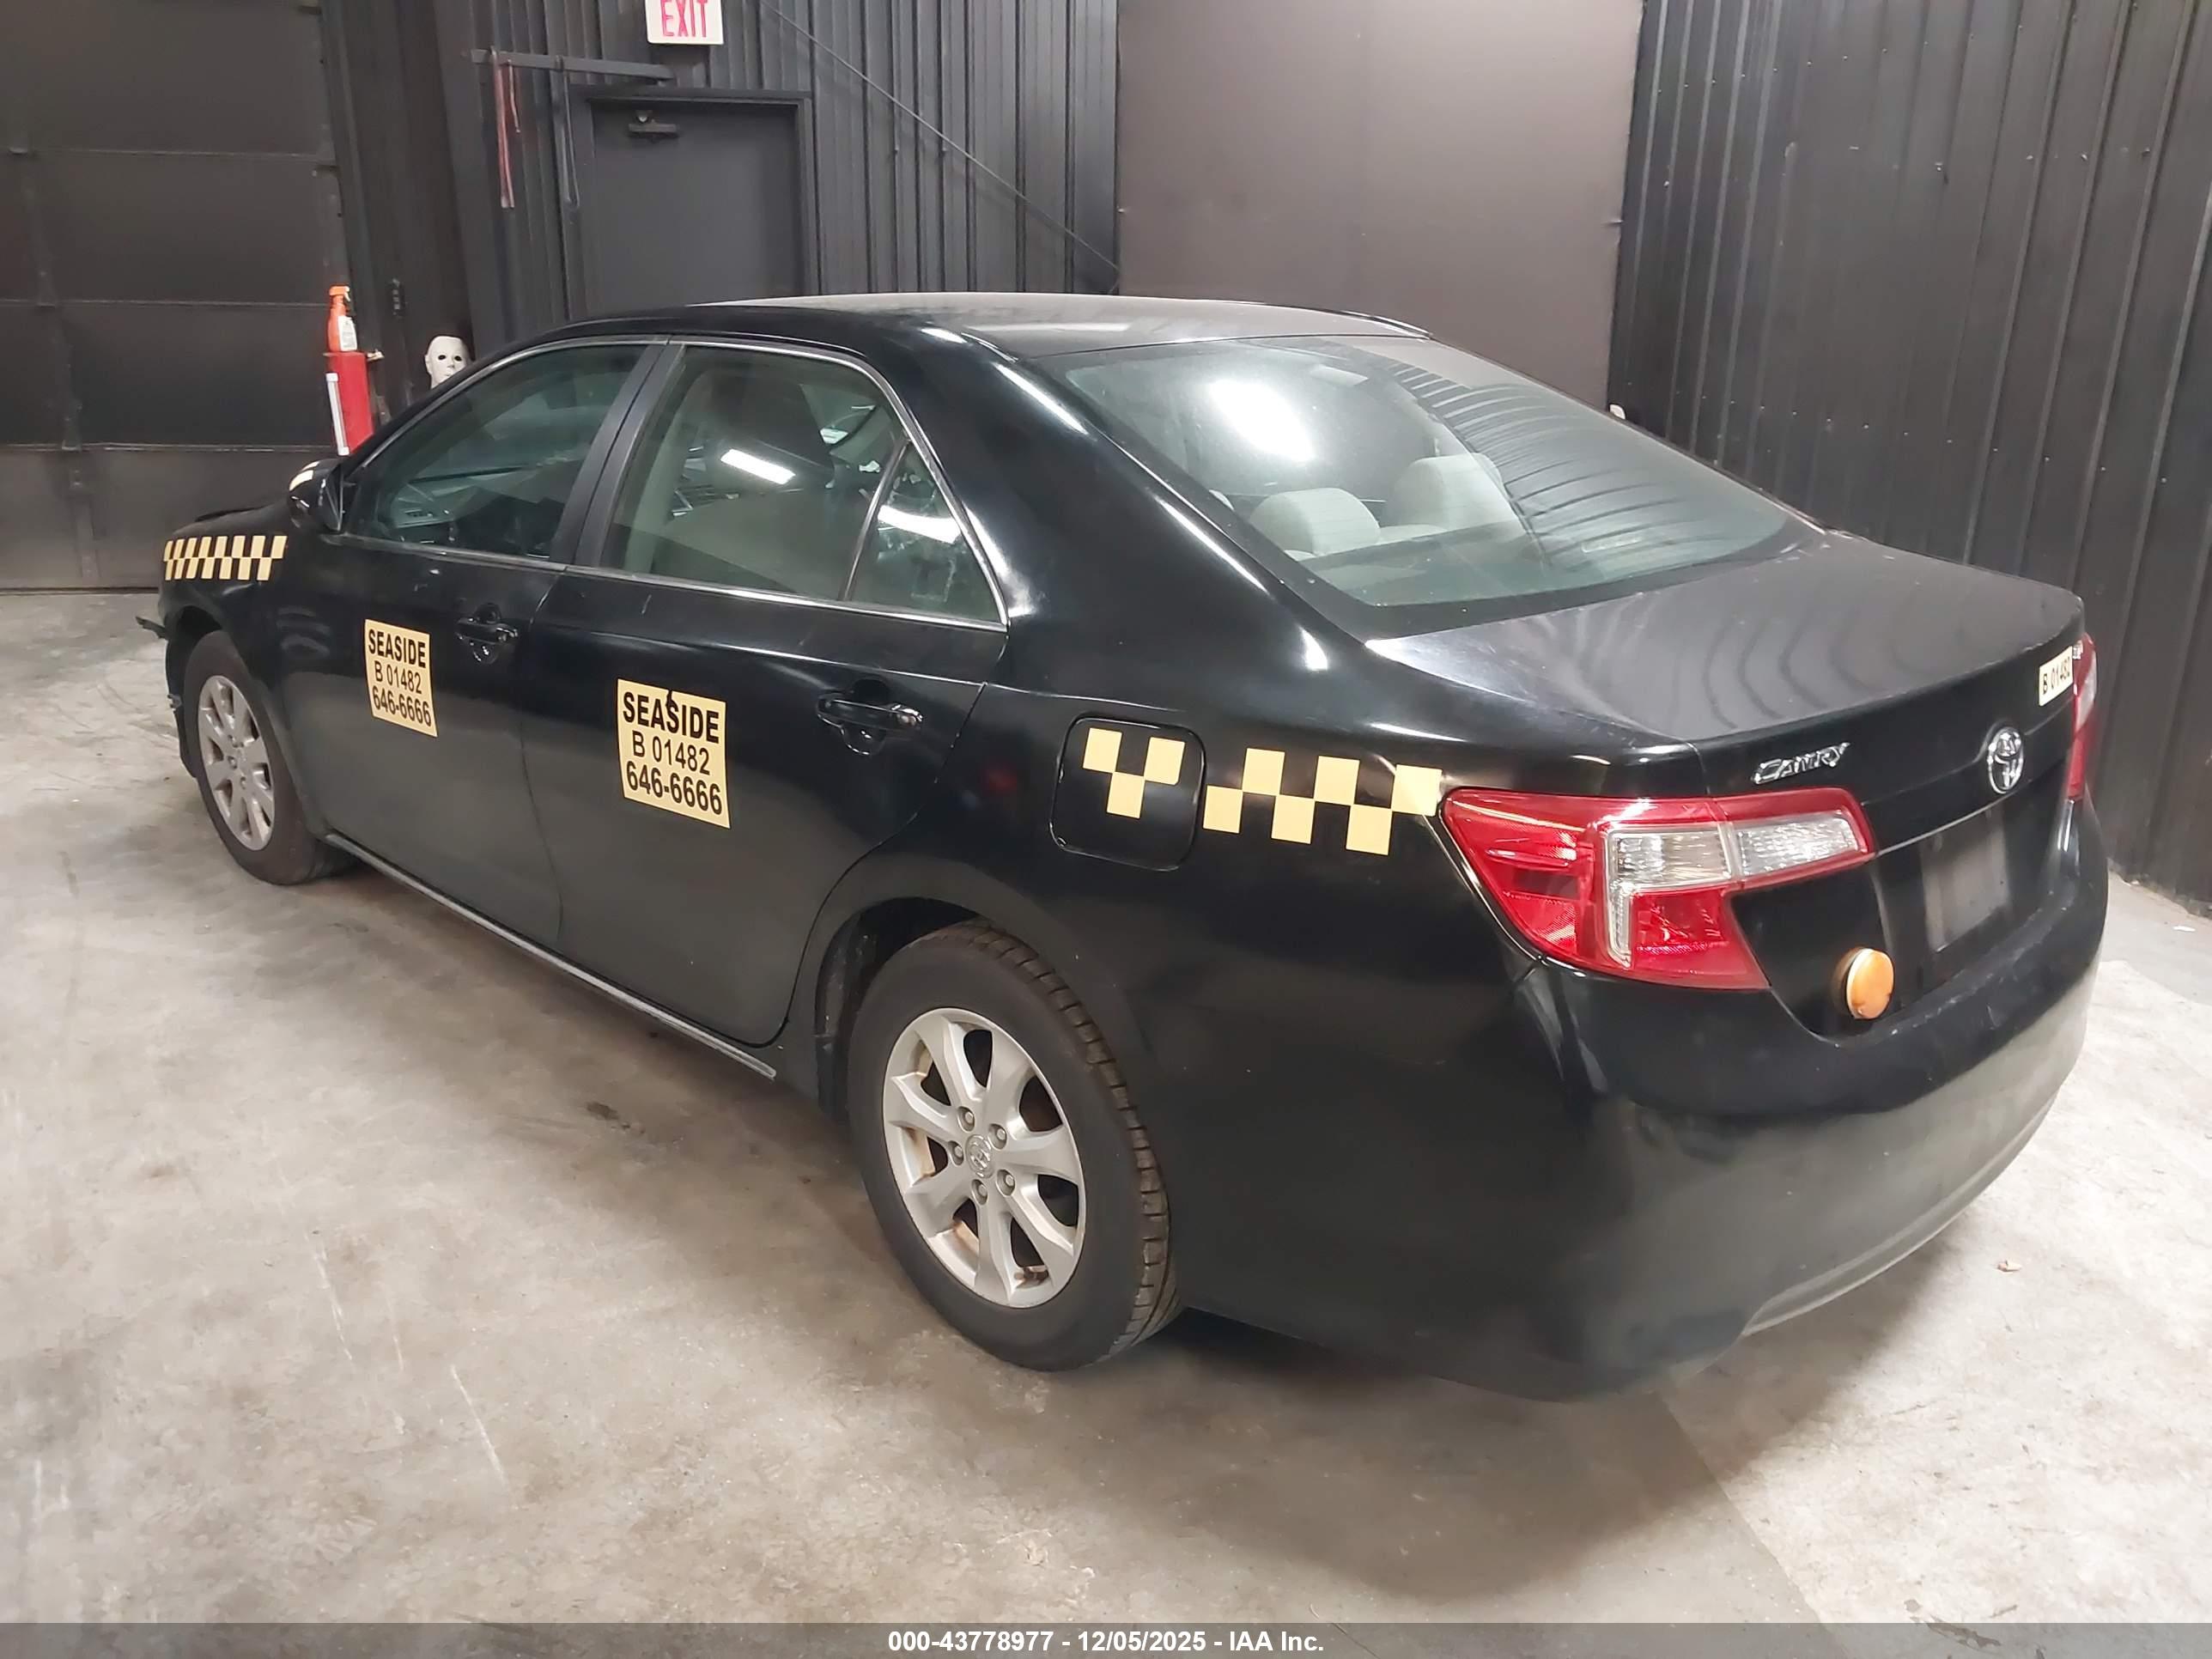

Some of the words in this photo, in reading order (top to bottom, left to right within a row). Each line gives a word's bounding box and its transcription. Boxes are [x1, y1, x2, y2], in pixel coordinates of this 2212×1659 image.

[659, 0, 707, 38] EXIT
[368, 629, 426, 668] SEASIDE
[374, 660, 384, 682] B
[386, 664, 422, 695] 01482
[2043, 673, 2049, 695] B
[372, 685, 431, 727] 646-6666
[623, 691, 720, 744] SEASIDE
[632, 730, 646, 757] B
[652, 736, 711, 776] 01482
[626, 761, 723, 816] 646-6666
